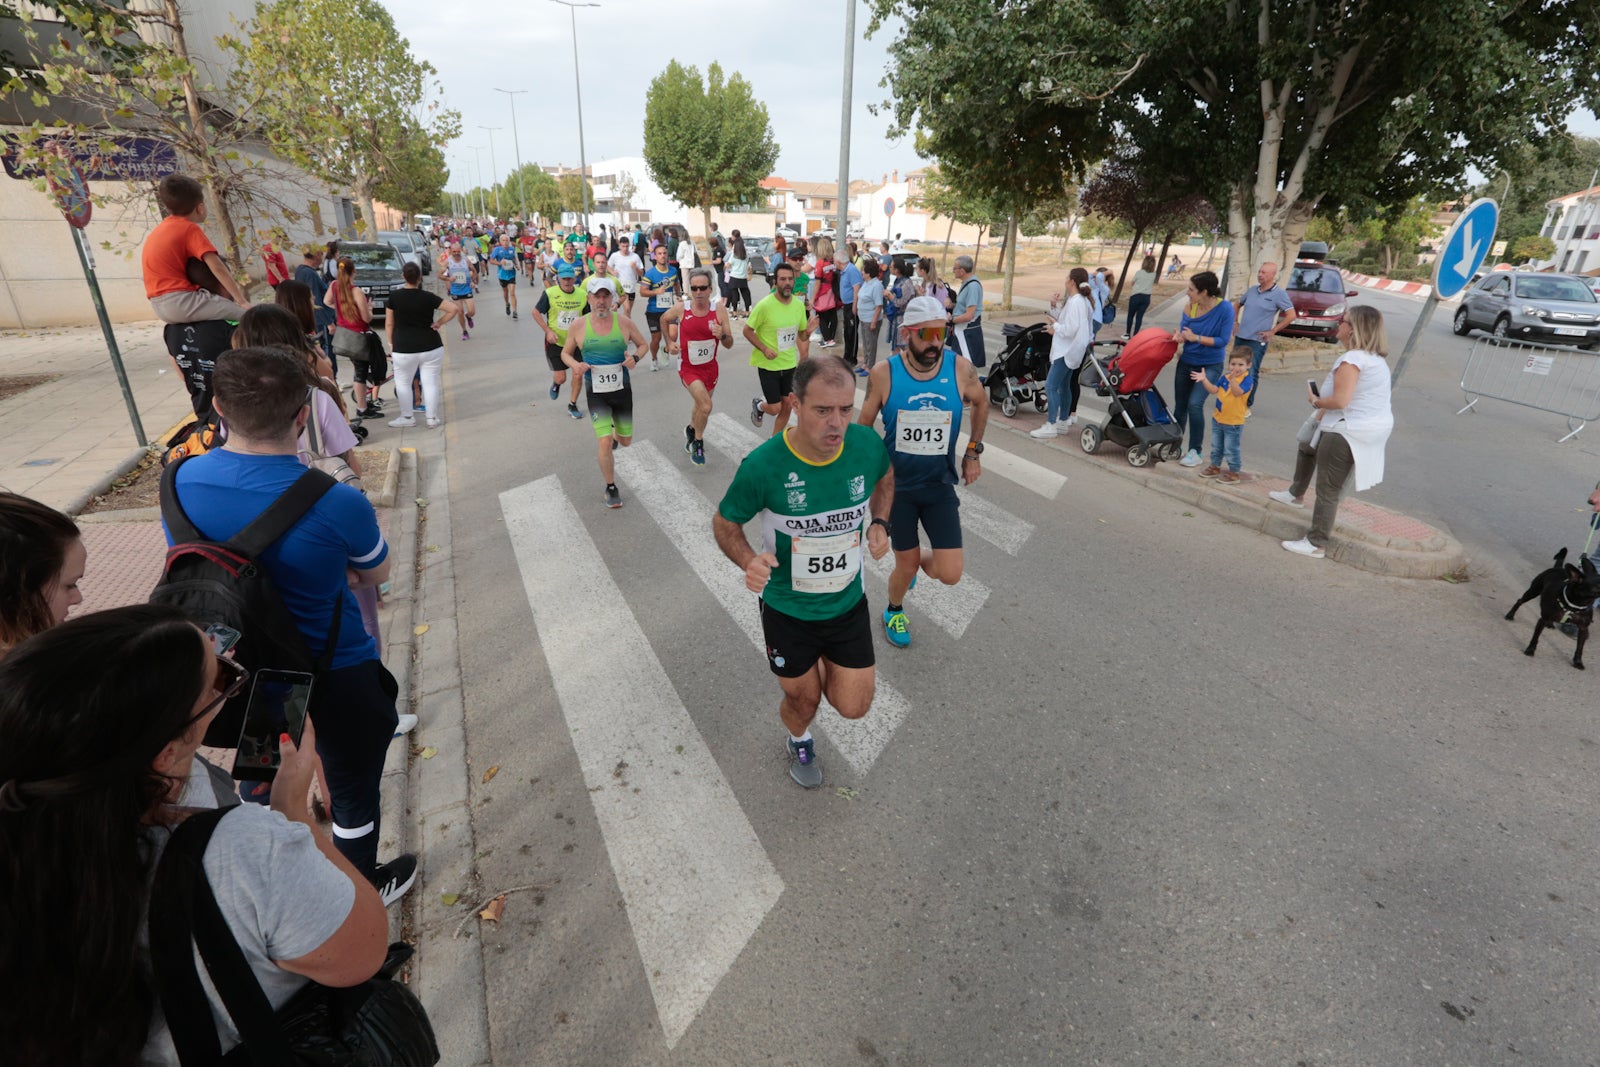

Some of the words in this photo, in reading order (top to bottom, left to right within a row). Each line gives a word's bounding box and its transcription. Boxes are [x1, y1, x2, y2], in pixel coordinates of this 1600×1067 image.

[782, 333, 796, 342] 172
[698, 348, 709, 356] 20
[598, 373, 618, 384] 319
[902, 428, 943, 442] 3013
[785, 518, 820, 530] CAJA
[804, 522, 853, 535] GRANADA
[807, 553, 847, 574] 584
